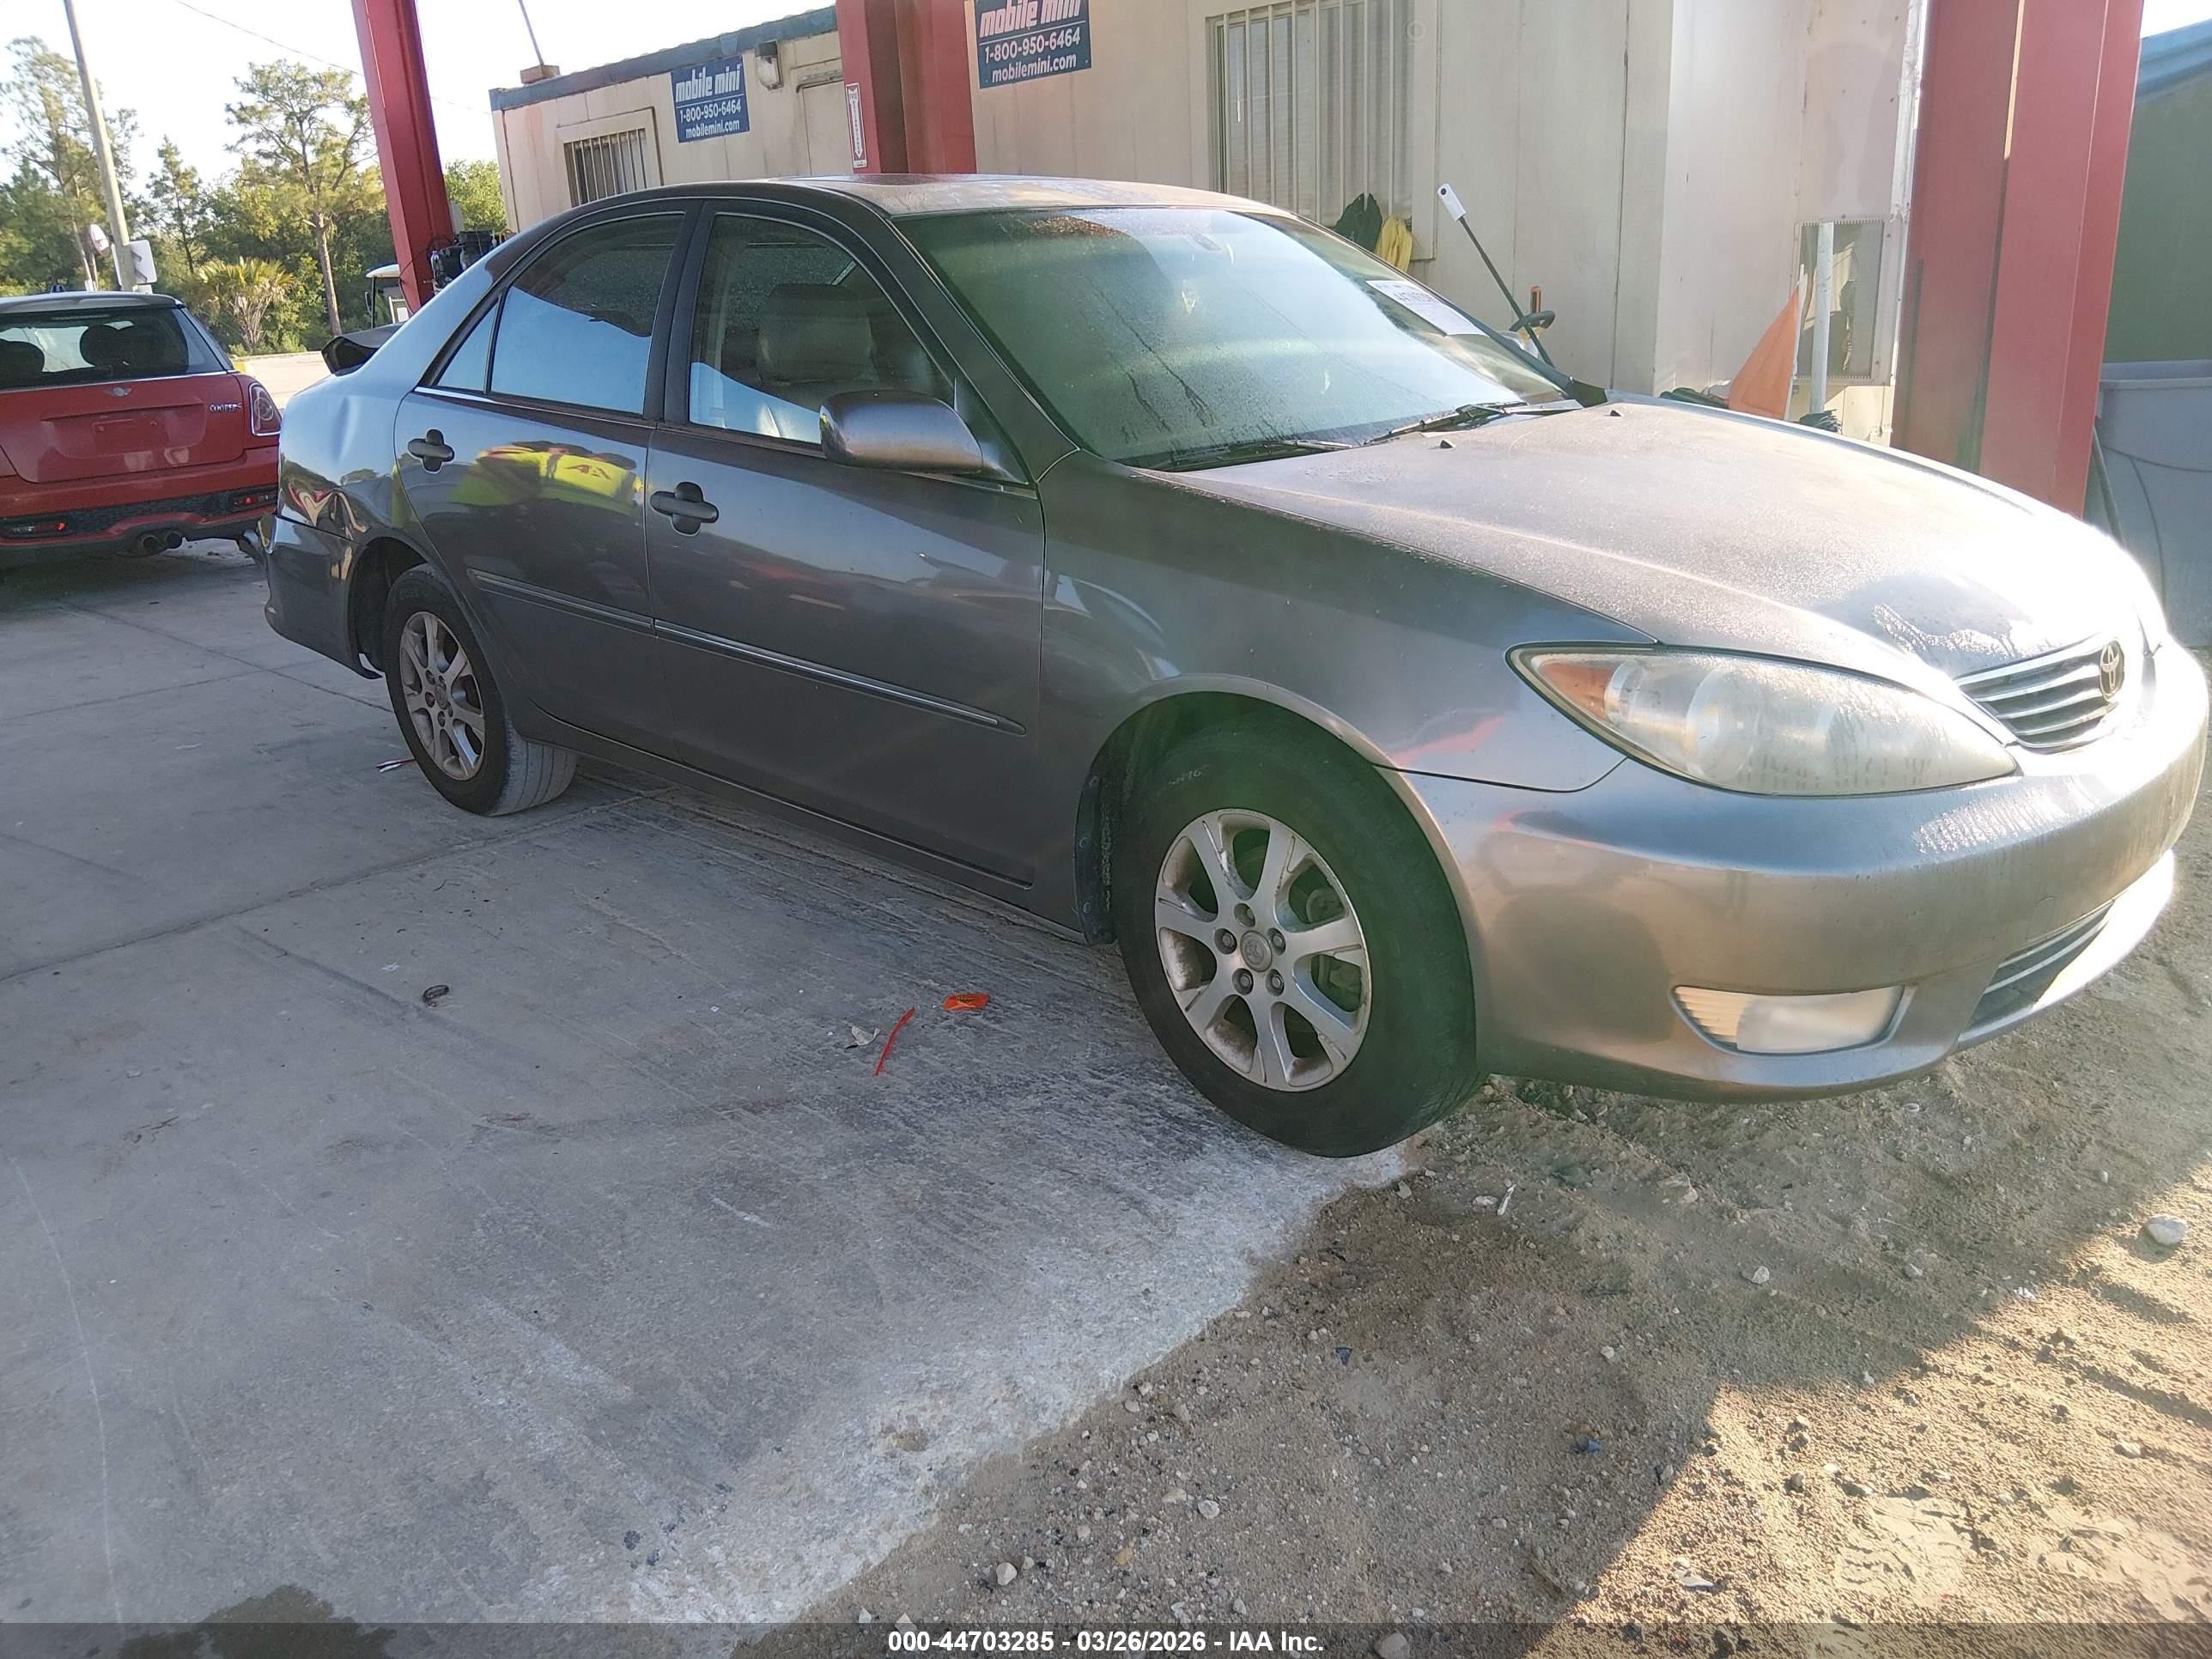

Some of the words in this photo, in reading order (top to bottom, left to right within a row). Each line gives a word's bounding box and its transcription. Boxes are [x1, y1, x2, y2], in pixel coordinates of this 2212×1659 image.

[979, 0, 1038, 38] mobile
[985, 27, 1080, 64] 1-800-950-6464
[675, 66, 713, 103] mobile
[714, 64, 742, 94] mini
[992, 53, 1077, 83] mobilemini.com
[679, 98, 742, 124] 1-800-950-6464
[685, 119, 740, 139] mobilemini.com
